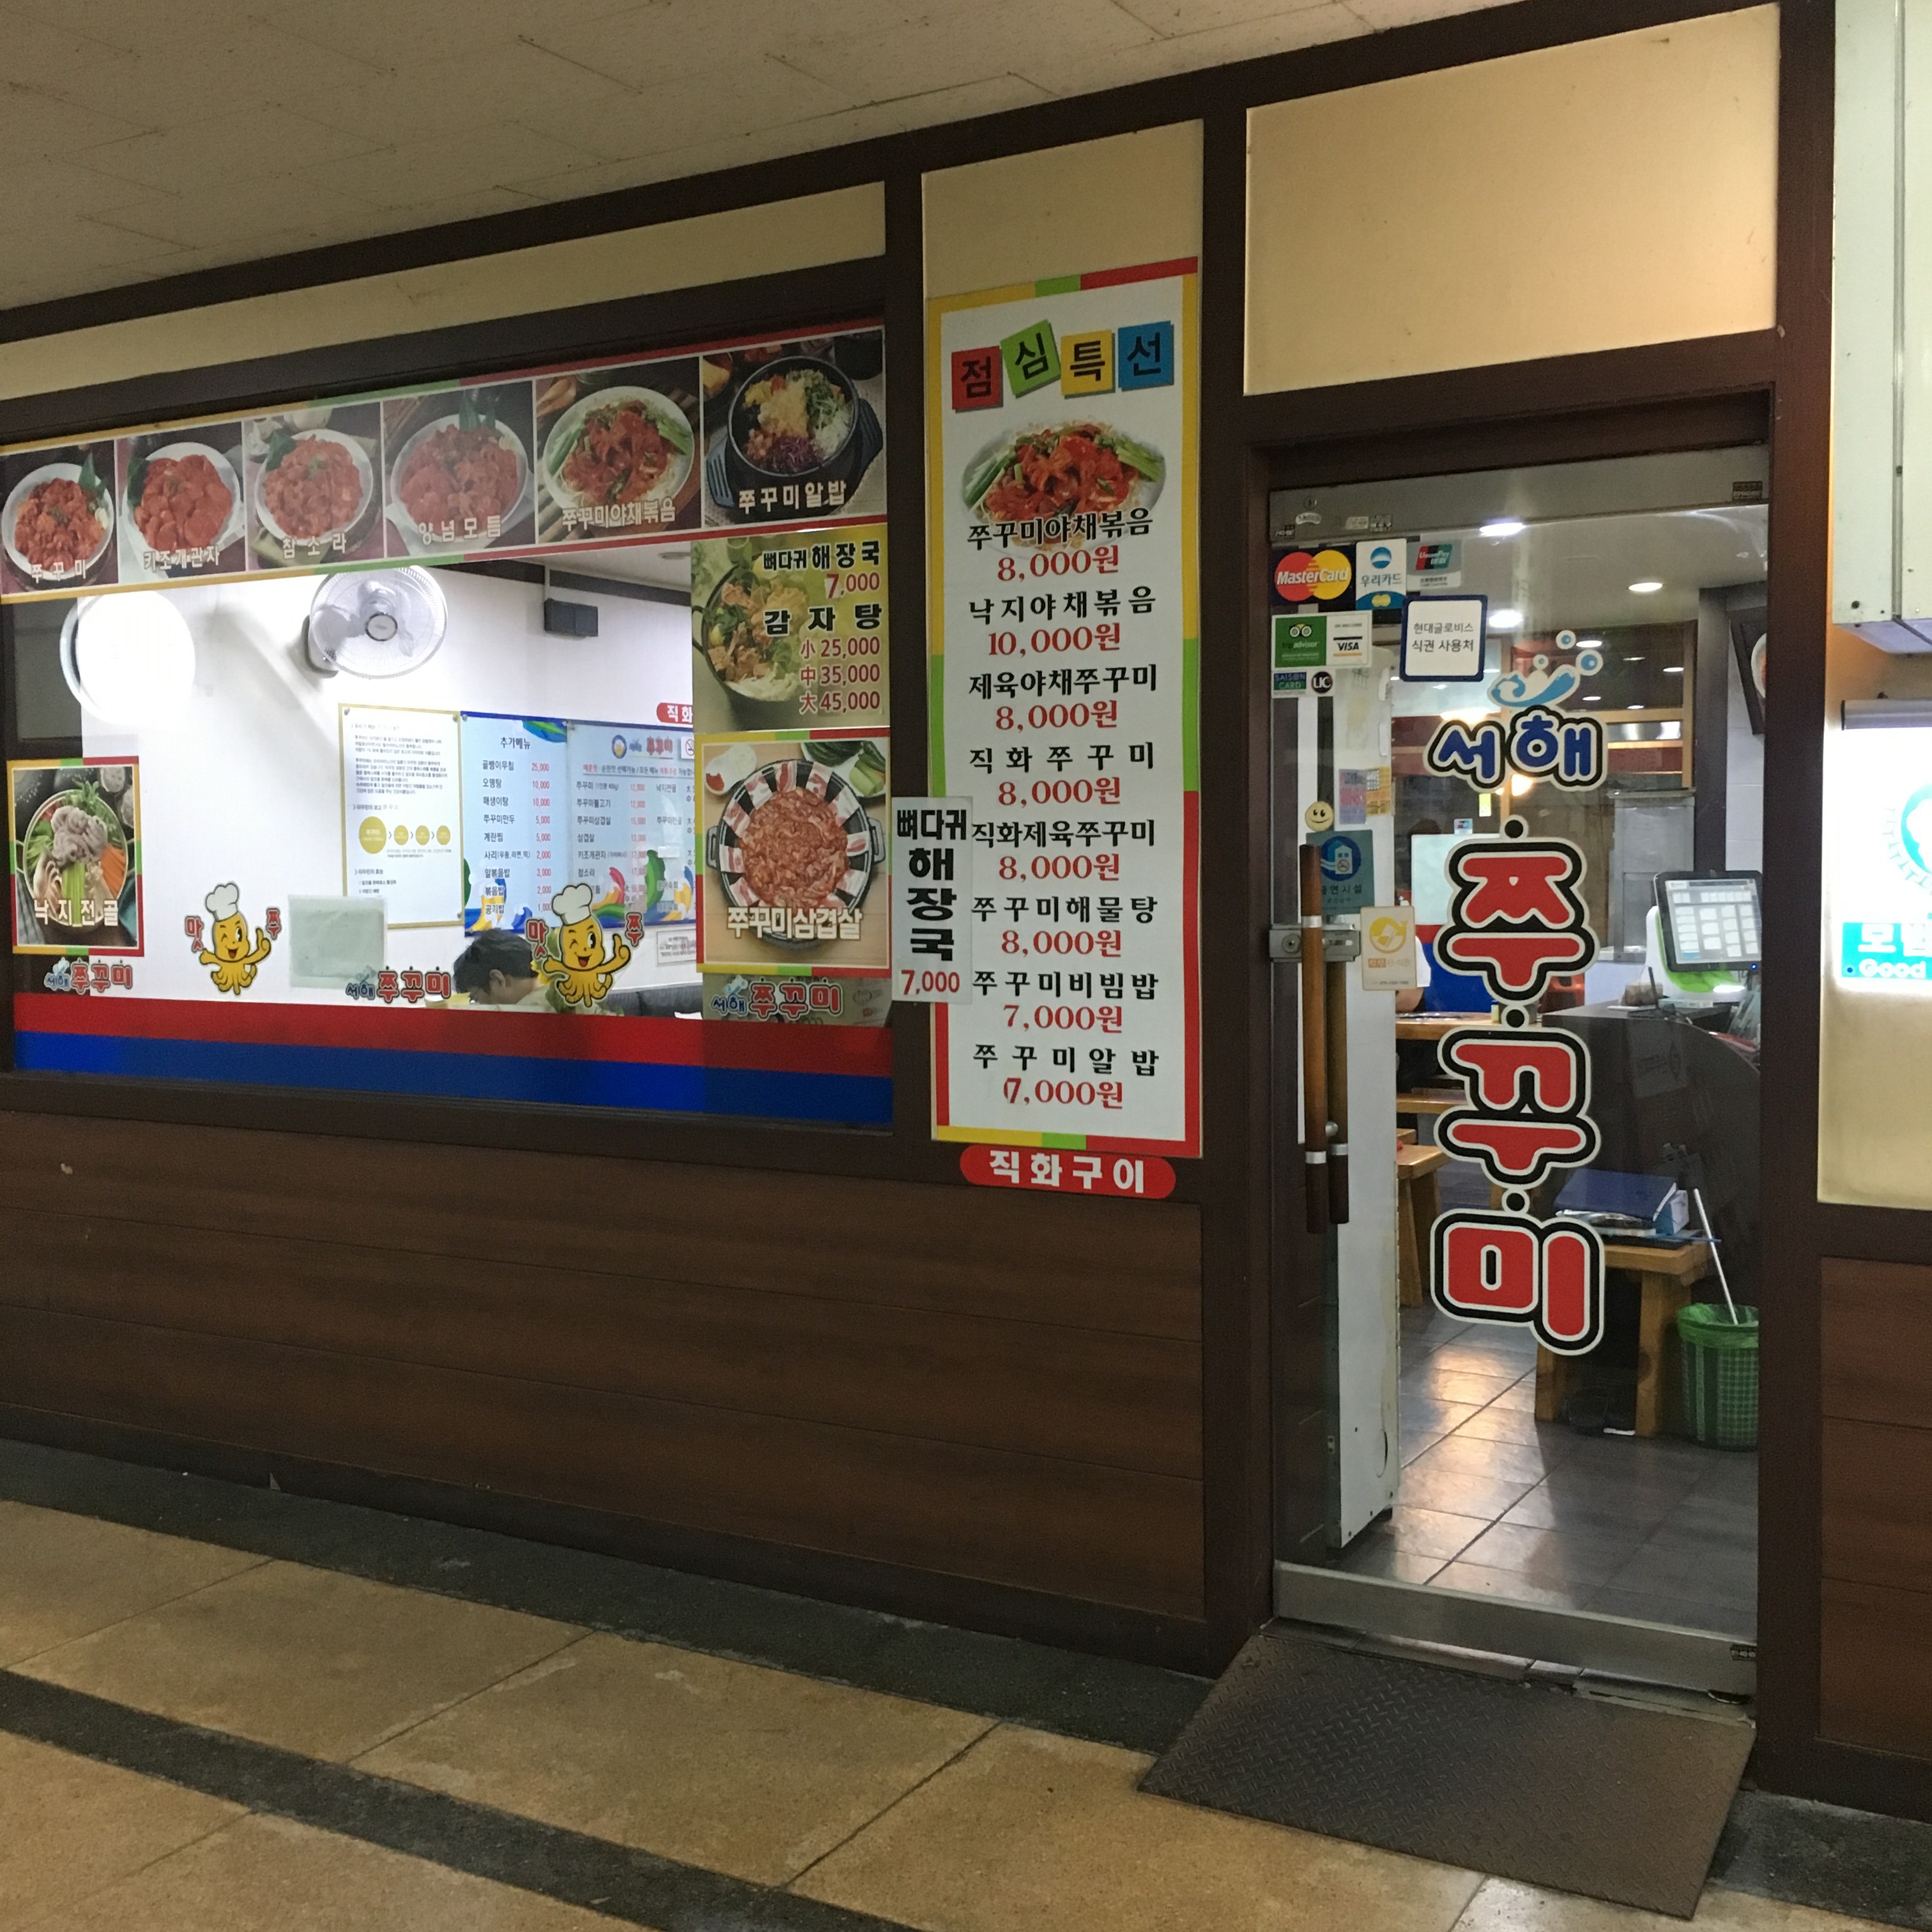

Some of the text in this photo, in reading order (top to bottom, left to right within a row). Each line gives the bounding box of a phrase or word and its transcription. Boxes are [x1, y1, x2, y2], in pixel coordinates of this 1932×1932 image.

[562, 497, 676, 531] 쭈꾸미야채볶음
[967, 508, 1153, 550] 쭈꾸미야채볶음
[144, 545, 220, 572] 키조개관자
[997, 545, 1119, 582] 8,000원
[826, 572, 880, 598] 7,000
[1276, 567, 1350, 586] MasterCard
[1360, 573, 1402, 587] 우리카드
[969, 586, 1156, 625] 낙지야채볶음
[988, 622, 1120, 657] 10,000원
[1414, 623, 1474, 634] 현대글로비스
[801, 636, 880, 659] 小 25,000
[1338, 642, 1359, 650] VISA
[1412, 639, 1473, 652] 식권 사용처
[801, 664, 880, 686] 中 35,000
[968, 664, 1156, 700] 제육야채쭈꾸미
[801, 691, 880, 713] 大 45,000
[995, 700, 1117, 733] 8,000원
[500, 737, 530, 749] 추가메뉴
[1428, 705, 1602, 788] 서해
[532, 762, 549, 772] 25,000
[969, 742, 1153, 774] 직화쭈꾸미
[532, 781, 549, 790] 10,000
[998, 777, 1121, 808] 8,000원
[533, 798, 550, 808] 10,000
[535, 815, 551, 825] 5,000
[897, 809, 967, 841] 뼈다귀
[536, 833, 551, 843] 5,000
[971, 819, 1154, 848] 직화제육쭈꾸미
[537, 850, 551, 860] 2,000
[537, 868, 551, 878] 3,000
[999, 854, 1120, 883] 8,000원
[485, 885, 551, 896] 볶음밥 2,000
[34, 899, 118, 926] 낙지전골
[486, 905, 505, 915] 공기밥
[971, 896, 1158, 923] 쭈꾸미해물탕
[728, 907, 863, 940] 쭈꾸미삼겹살
[1001, 930, 1121, 958] 8,000원
[1859, 958, 1926, 979] Good
[346, 981, 375, 1000] 서해
[901, 969, 960, 995] 7,000
[972, 970, 1158, 1000] 쭈꾸미비빔밥
[712, 993, 746, 1017] 서해
[1003, 1004, 1123, 1034] 7,000원
[973, 1044, 1160, 1077] 쭈꾸미알밥
[989, 1150, 1144, 1193] 직화구이
